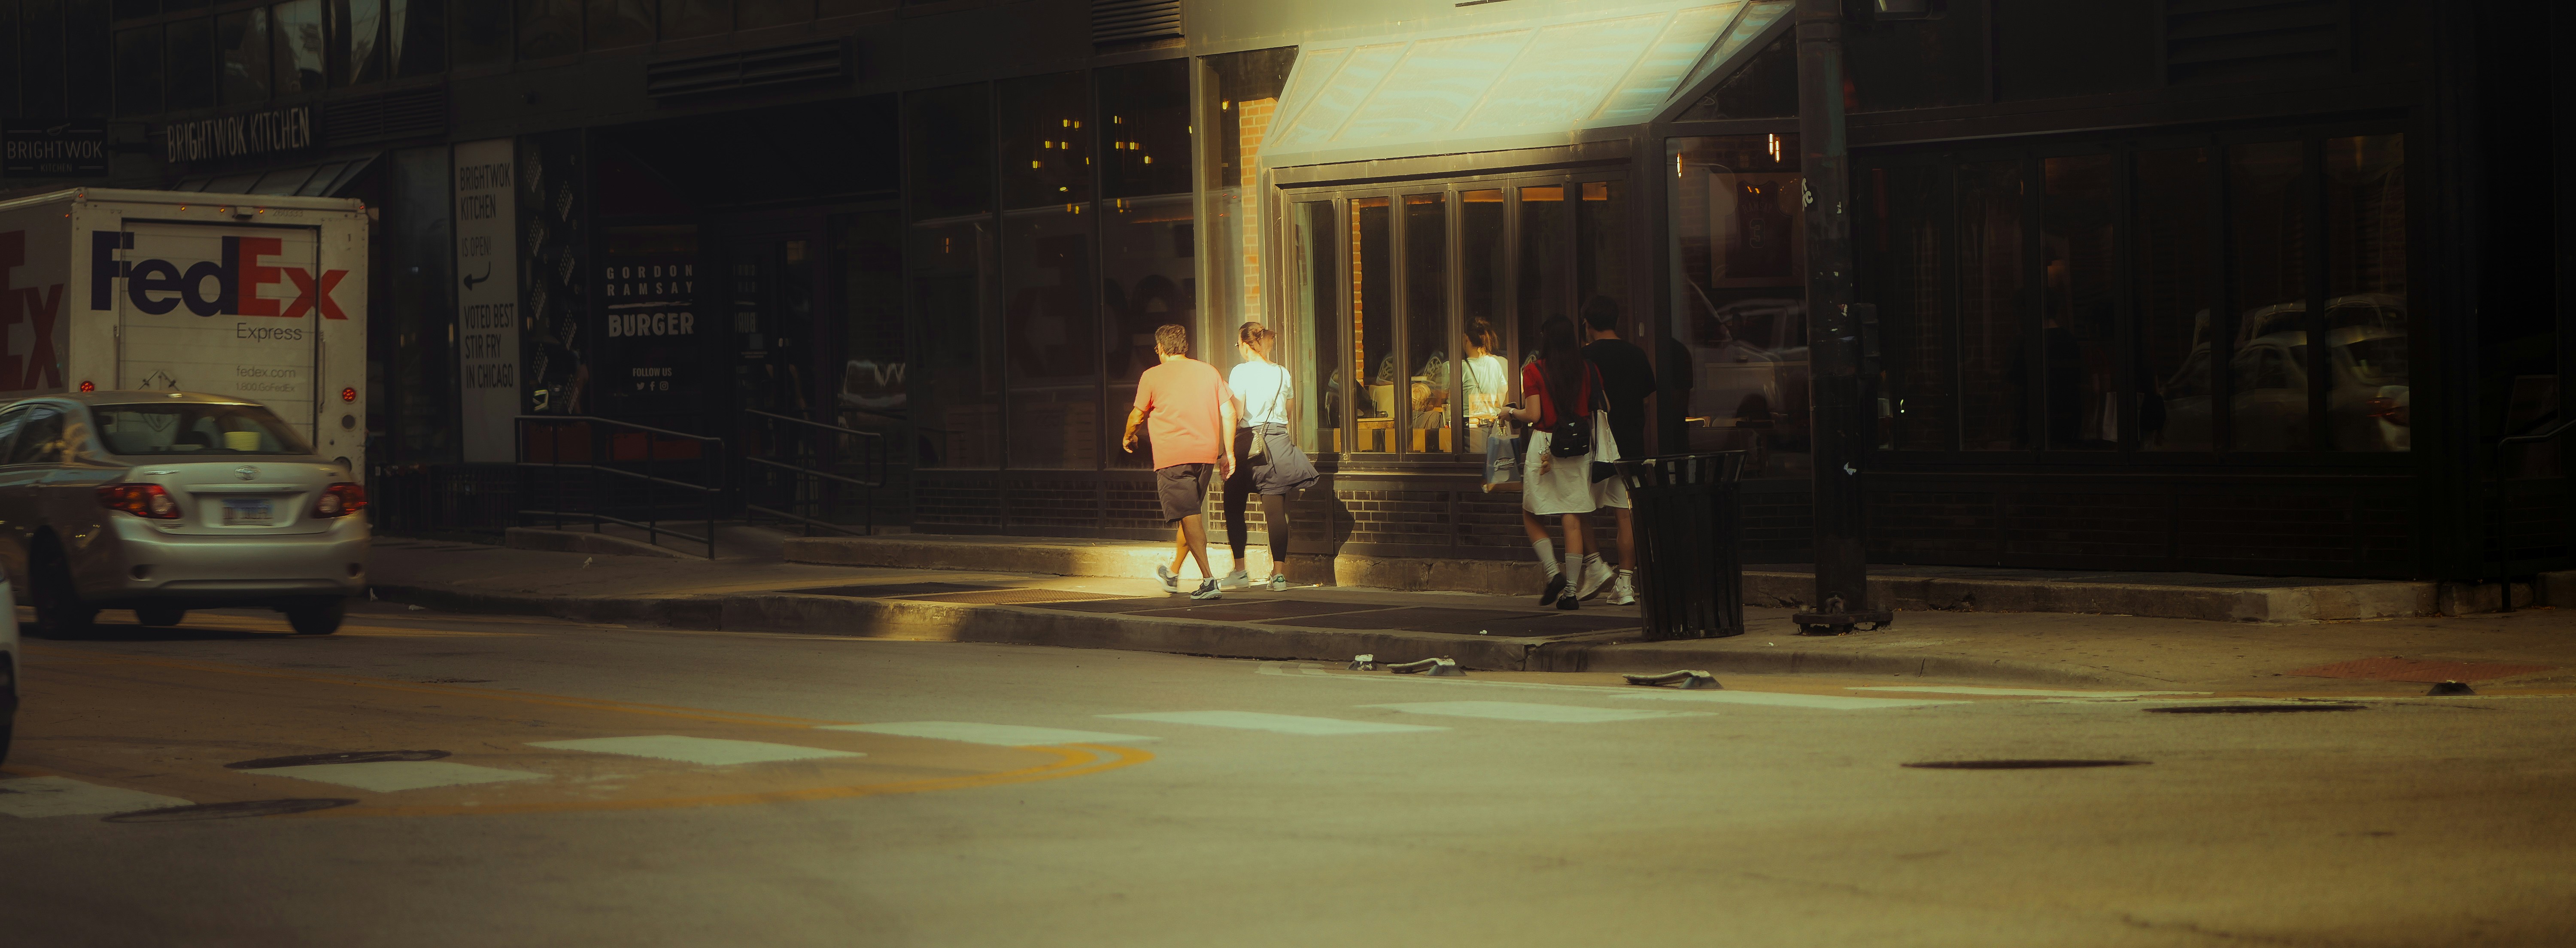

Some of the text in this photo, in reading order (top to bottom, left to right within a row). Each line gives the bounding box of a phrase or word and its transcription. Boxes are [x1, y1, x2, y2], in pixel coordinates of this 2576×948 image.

[167, 106, 310, 163] BRIGHTWOK KITCHEN
[7, 140, 103, 159] BRIGHTWOK
[41, 163, 72, 172] KITCHEN
[460, 163, 510, 191] BRIGHTWOK
[461, 194, 496, 221] KITCHEN
[1750, 218, 1765, 248] 3
[462, 236, 491, 257] IS OPEN!
[91, 231, 349, 320] FedEx
[607, 264, 693, 279] GORDON
[607, 281, 693, 296] RAMSAY
[464, 303, 514, 329] VOTED BEST
[608, 312, 694, 337] BURGER
[237, 322, 302, 343] Express
[465, 334, 501, 359] STIR FRY
[237, 366, 296, 378] fedex.com
[467, 363, 513, 389] IN CHICAGO
[632, 367, 672, 377] FOLLOW US
